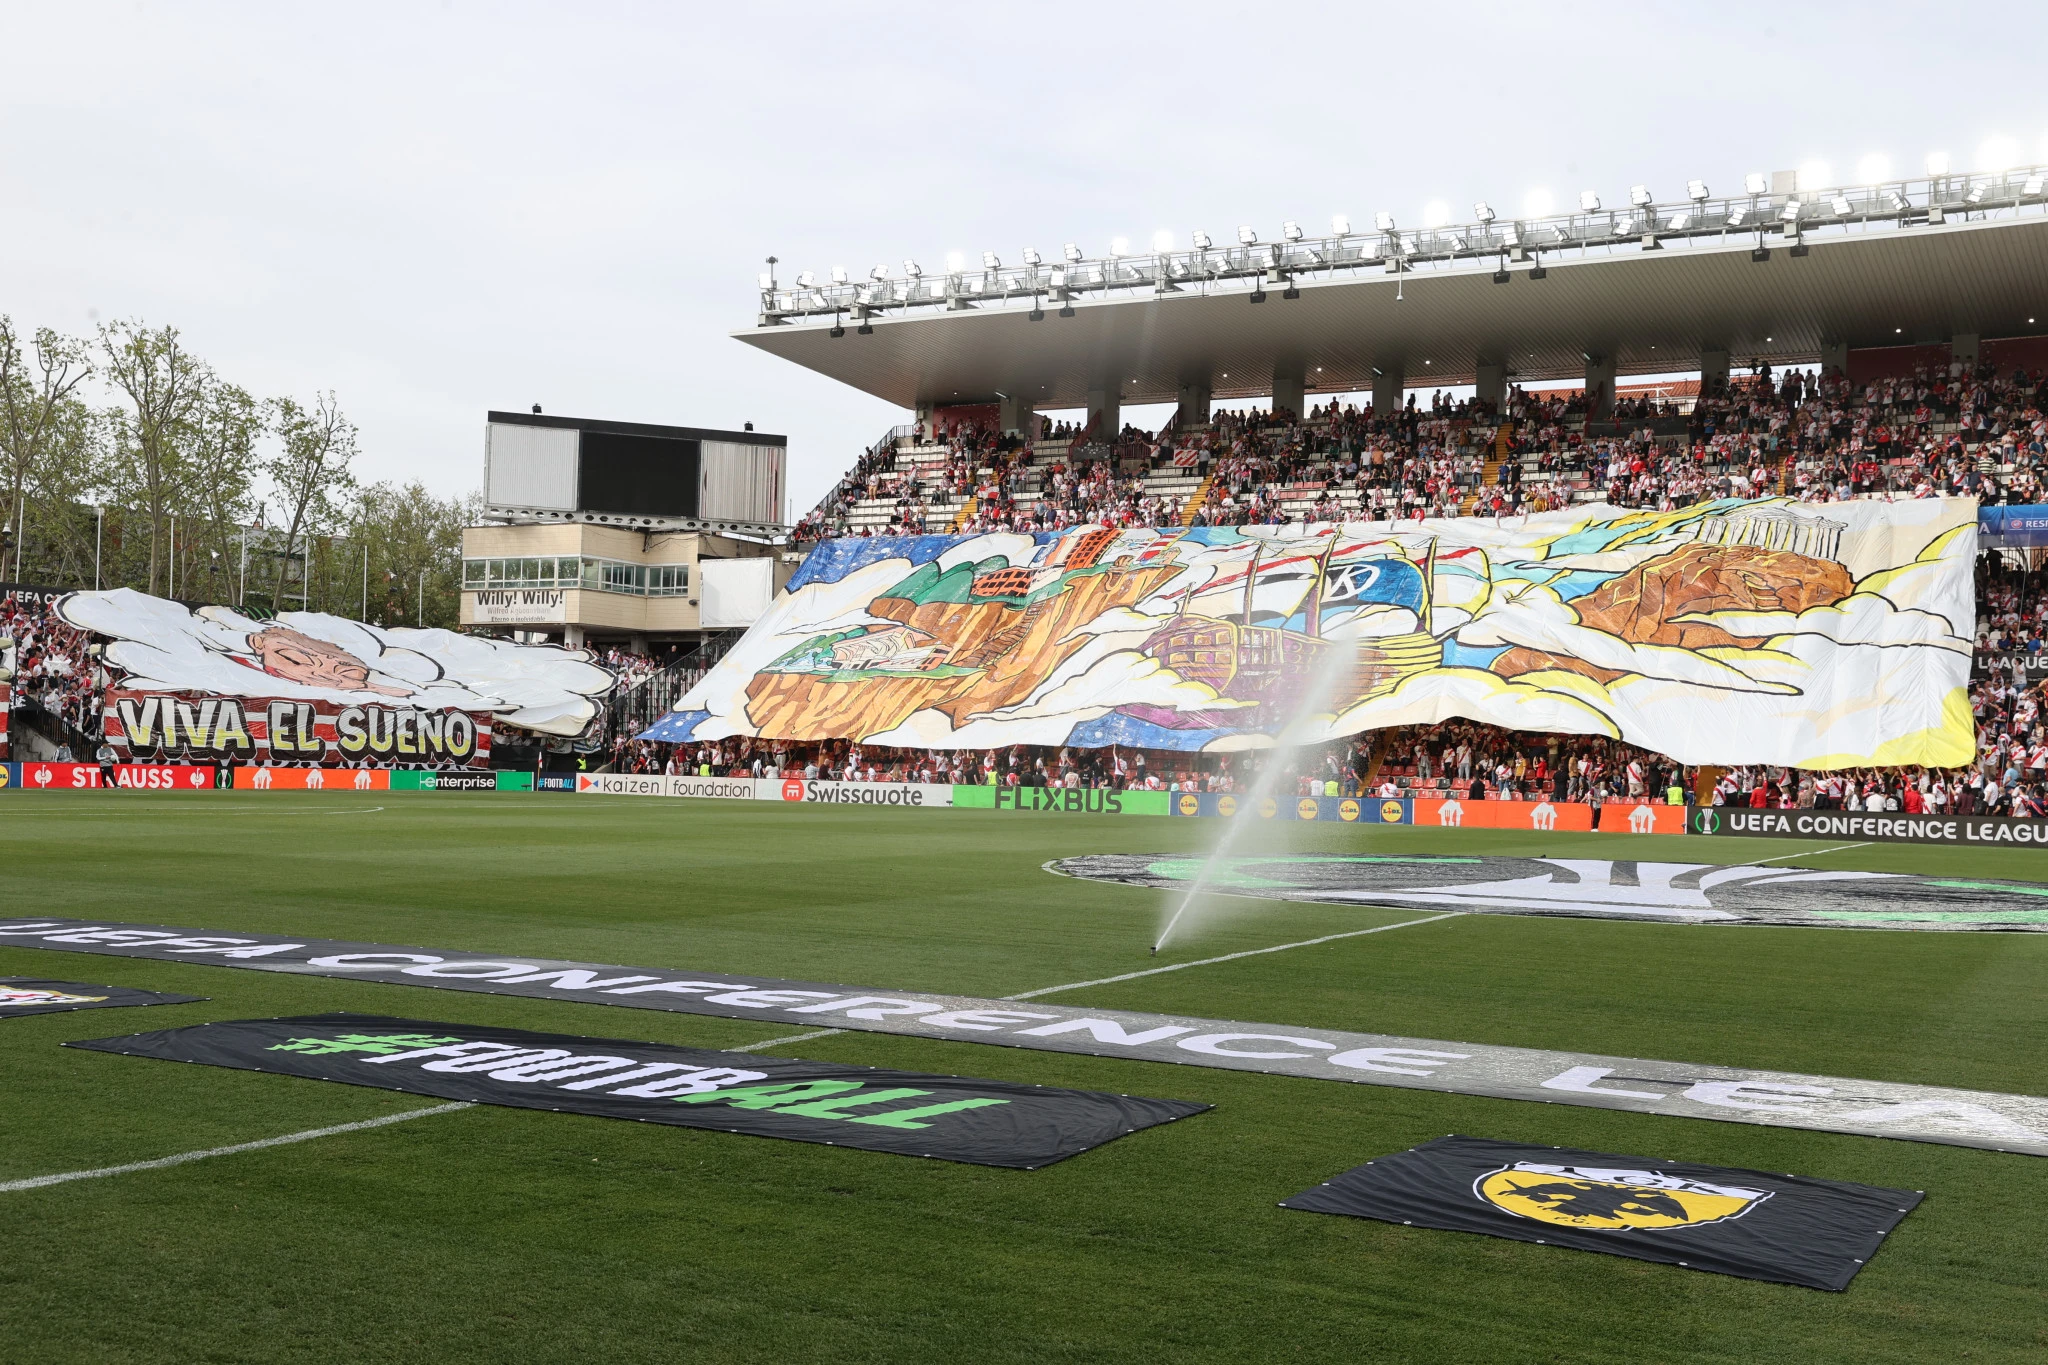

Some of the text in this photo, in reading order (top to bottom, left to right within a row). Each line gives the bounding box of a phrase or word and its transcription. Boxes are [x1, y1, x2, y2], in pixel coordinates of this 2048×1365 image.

[478, 590, 563, 608] Willy! Willy!
[118, 697, 252, 755] VIVA
[269, 701, 322, 755] EL
[72, 766, 174, 788] STAUSS
[422, 776, 496, 790] enterprise
[538, 777, 574, 789] #FOOTBALL
[603, 777, 751, 797] kaizen foundation
[1730, 814, 1791, 832] UEFA
[1797, 815, 1957, 839] CONFERENCE
[0, 922, 307, 959] UEFA
[306, 953, 1472, 1077] CONFERENCE
